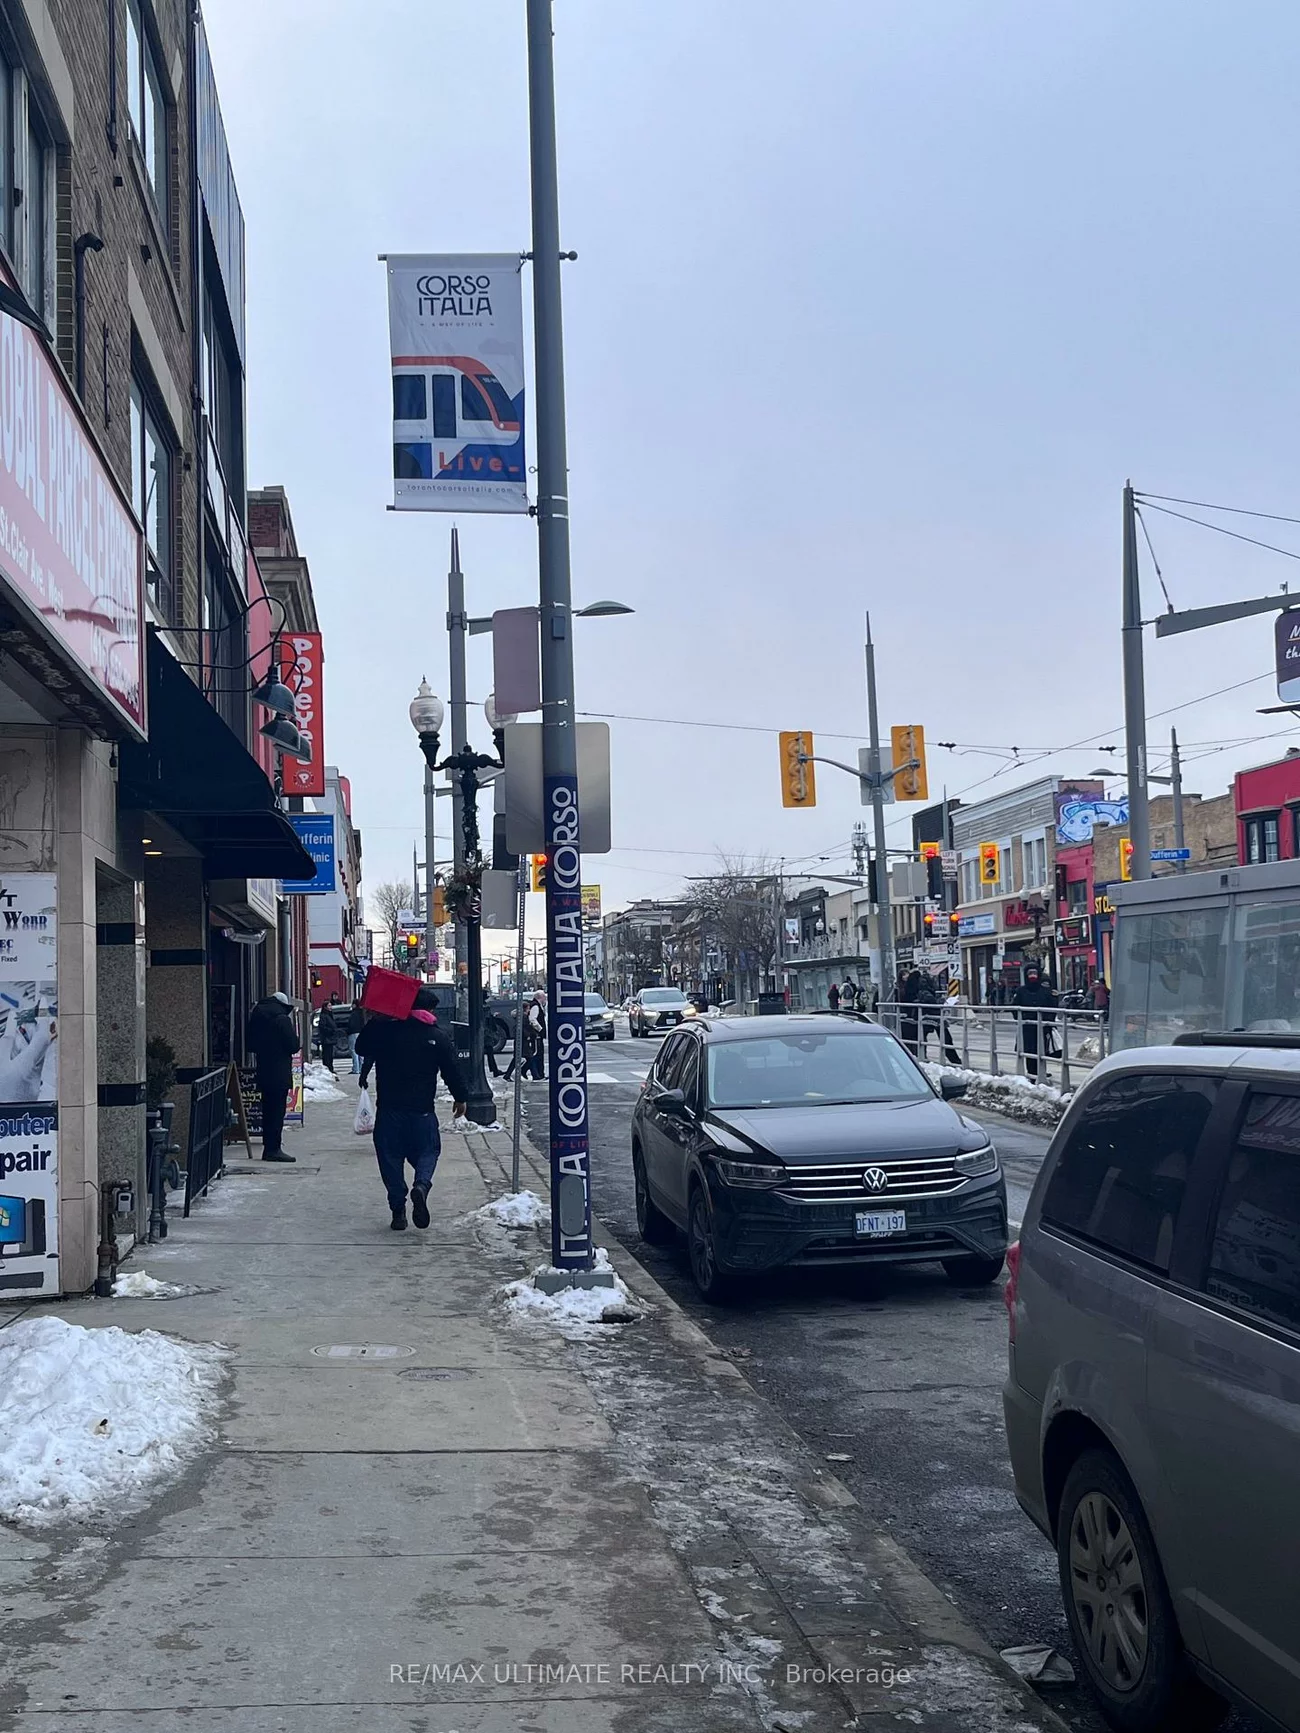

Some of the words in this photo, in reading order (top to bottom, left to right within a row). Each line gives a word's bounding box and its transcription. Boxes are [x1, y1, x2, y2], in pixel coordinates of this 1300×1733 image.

[416, 275, 490, 296] CORSO
[419, 297, 492, 316] ITALIA
[0, 310, 45, 522] OBAL
[48, 380, 95, 598] PARCEL
[552, 786, 580, 888] CORSO
[555, 911, 583, 1013] ITALIA
[557, 1023, 585, 1127] CORSO
[887, 1215, 905, 1229] 197
